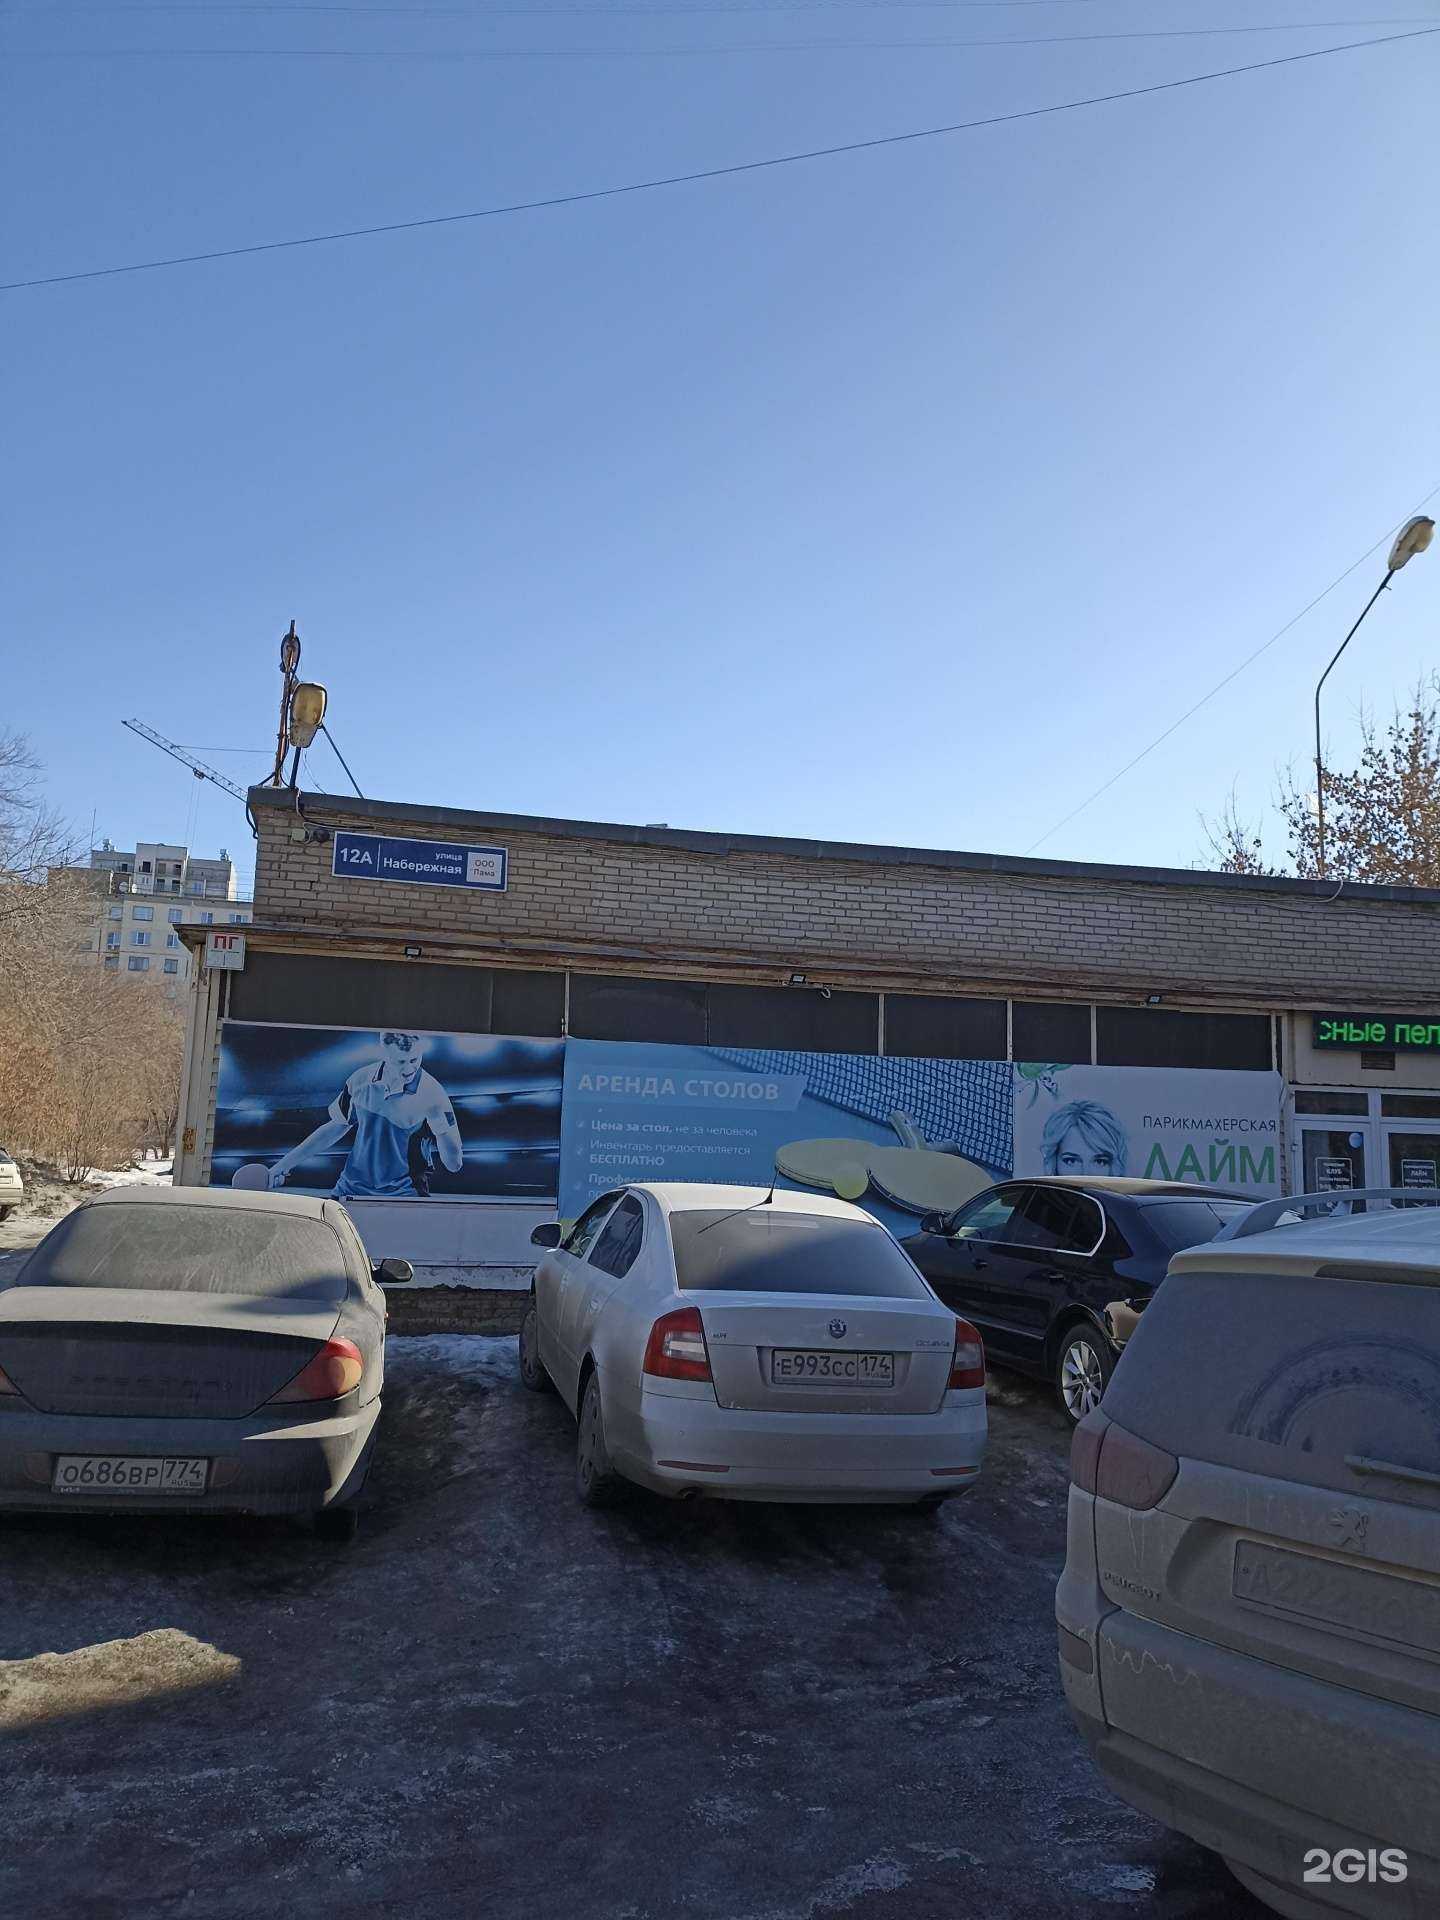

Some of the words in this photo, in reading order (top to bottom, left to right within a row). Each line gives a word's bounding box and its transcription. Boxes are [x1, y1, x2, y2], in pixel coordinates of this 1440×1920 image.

[340, 848, 373, 865] 12А
[435, 851, 463, 861] улица
[474, 859, 495, 868] ООО
[383, 857, 463, 875] Набережная
[213, 935, 239, 949] ПГ
[577, 1073, 677, 1098] АРЕНДА
[683, 1078, 780, 1101] СТОЛОВ
[591, 1120, 623, 1132] Цена
[626, 1122, 639, 1132] за
[641, 1123, 673, 1134] стол,
[675, 1126, 689, 1135] не
[691, 1126, 703, 1135] за
[706, 1126, 758, 1137] человека
[1142, 1115, 1277, 1133] ПАРИКМАХЕРСКАЯ
[590, 1139, 652, 1152] Инвентарь
[655, 1143, 751, 1155] предоставляется
[589, 1154, 665, 1166] БЕСПЛАТНО
[1143, 1138, 1276, 1184] ЛАЙМ
